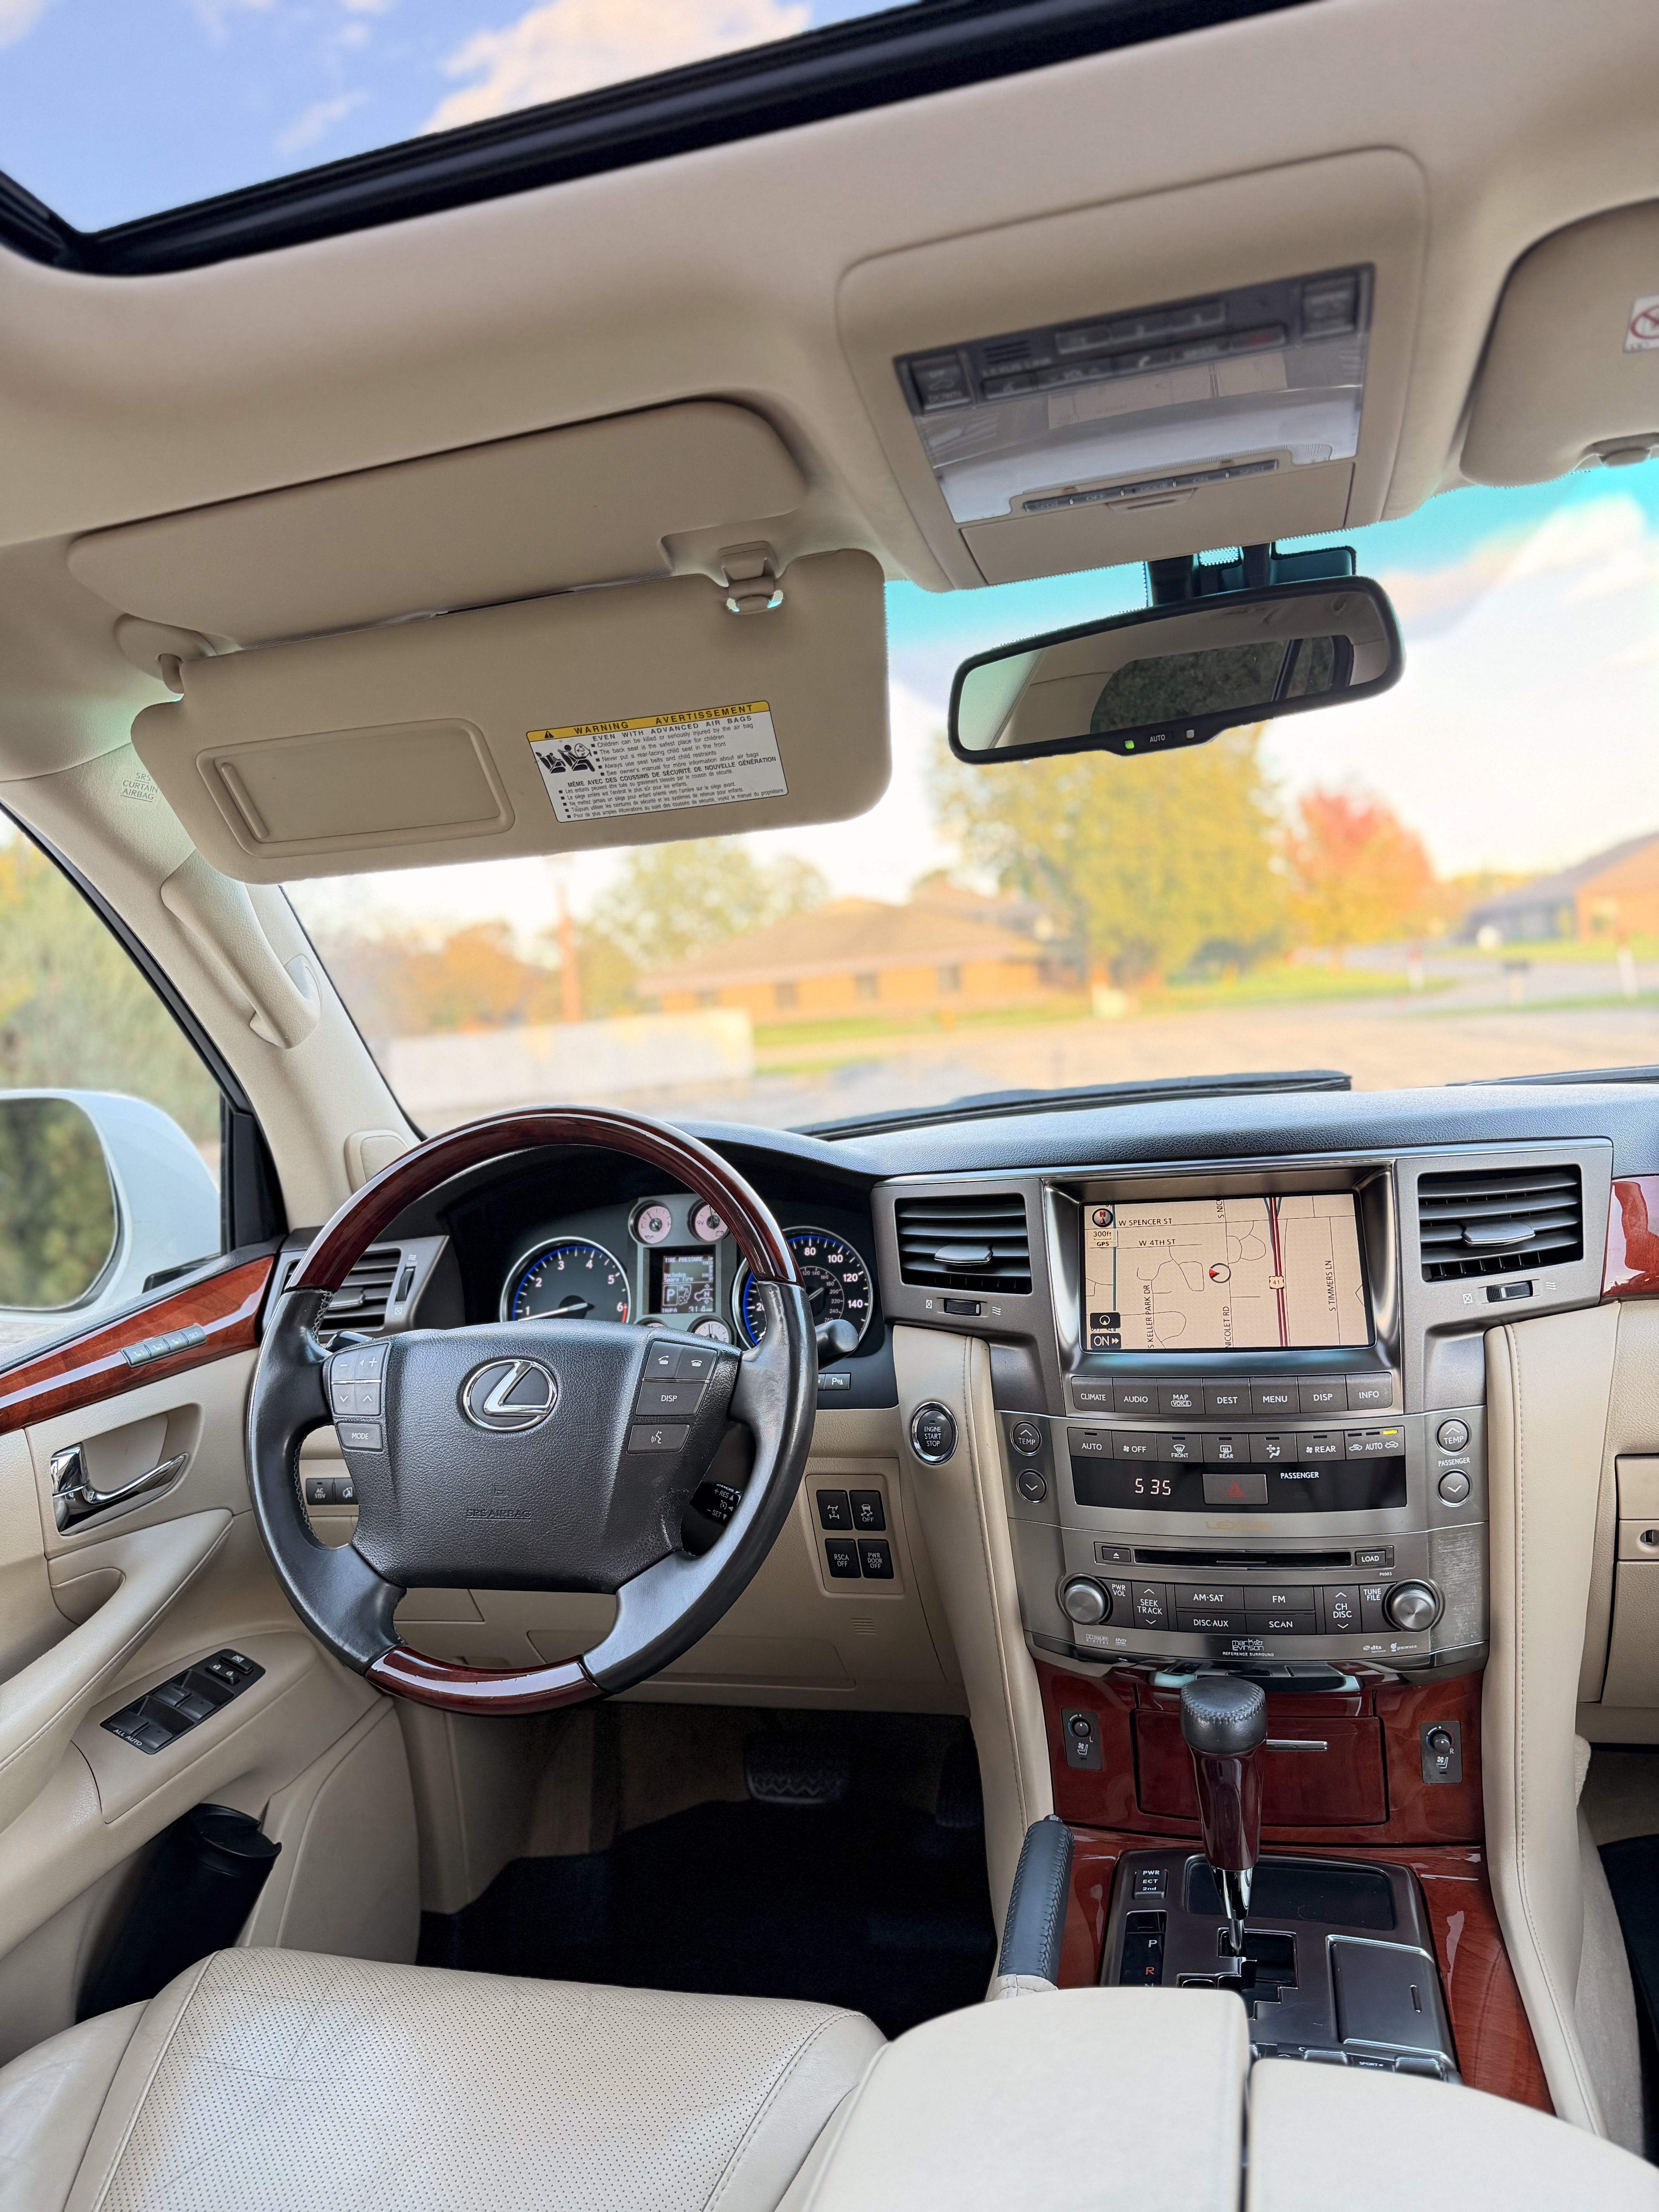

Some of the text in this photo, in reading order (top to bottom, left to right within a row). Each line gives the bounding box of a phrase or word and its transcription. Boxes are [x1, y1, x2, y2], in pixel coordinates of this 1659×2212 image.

[574, 704, 752, 735] WARNING AVERTISSEMENT
[651, 723, 698, 734] ADVANCED
[727, 715, 751, 723] BAGS
[1150, 734, 1165, 743] AUTO
[620, 773, 649, 781] COUSSINS
[704, 762, 735, 770] NOUVELLE
[135, 772, 151, 781] SRS
[122, 780, 159, 793] CURTAIN
[122, 788, 154, 800] AIRBAG
[804, 1247, 816, 1255] 80
[828, 1254, 843, 1263] 100
[558, 1261, 565, 1270] 3
[586, 1260, 593, 1269] 4
[1324, 1260, 1333, 1269] LN
[608, 1275, 614, 1285] 5
[843, 1273, 858, 1282] 120
[535, 1278, 543, 1287] 2
[1143, 1285, 1151, 1294] DR
[1325, 1272, 1335, 1305] TIMMERS
[617, 1302, 623, 1312] 6
[848, 1300, 863, 1308] 140
[526, 1306, 530, 1316] 1
[1146, 1317, 1154, 1343] KELLER
[1222, 1306, 1232, 1348] NICOLET RD
[1094, 1336, 1109, 1346] ON
[1080, 1393, 1106, 1401] CLIMATE
[1313, 1393, 1333, 1401] DISP
[1358, 1391, 1380, 1399] INFO
[1018, 1437, 1036, 1445] TEMP
[1443, 1435, 1464, 1445] TEMP
[1082, 1443, 1102, 1451] AUTO
[1315, 1445, 1336, 1453] REAR
[1365, 1442, 1383, 1451] AUTO
[1438, 1457, 1471, 1467] PASSENGER
[1280, 1472, 1319, 1480] PASSENGER
[719, 1490, 730, 1498] RES
[712, 1509, 722, 1518] SET
[1140, 1598, 1159, 1607] SEEK
[1137, 1606, 1163, 1615] TRACK
[1333, 1610, 1352, 1618] DISC
[125, 1735, 143, 1746] AUTO
[1148, 1940, 1158, 1948] P
[1145, 1966, 1155, 1975] R
